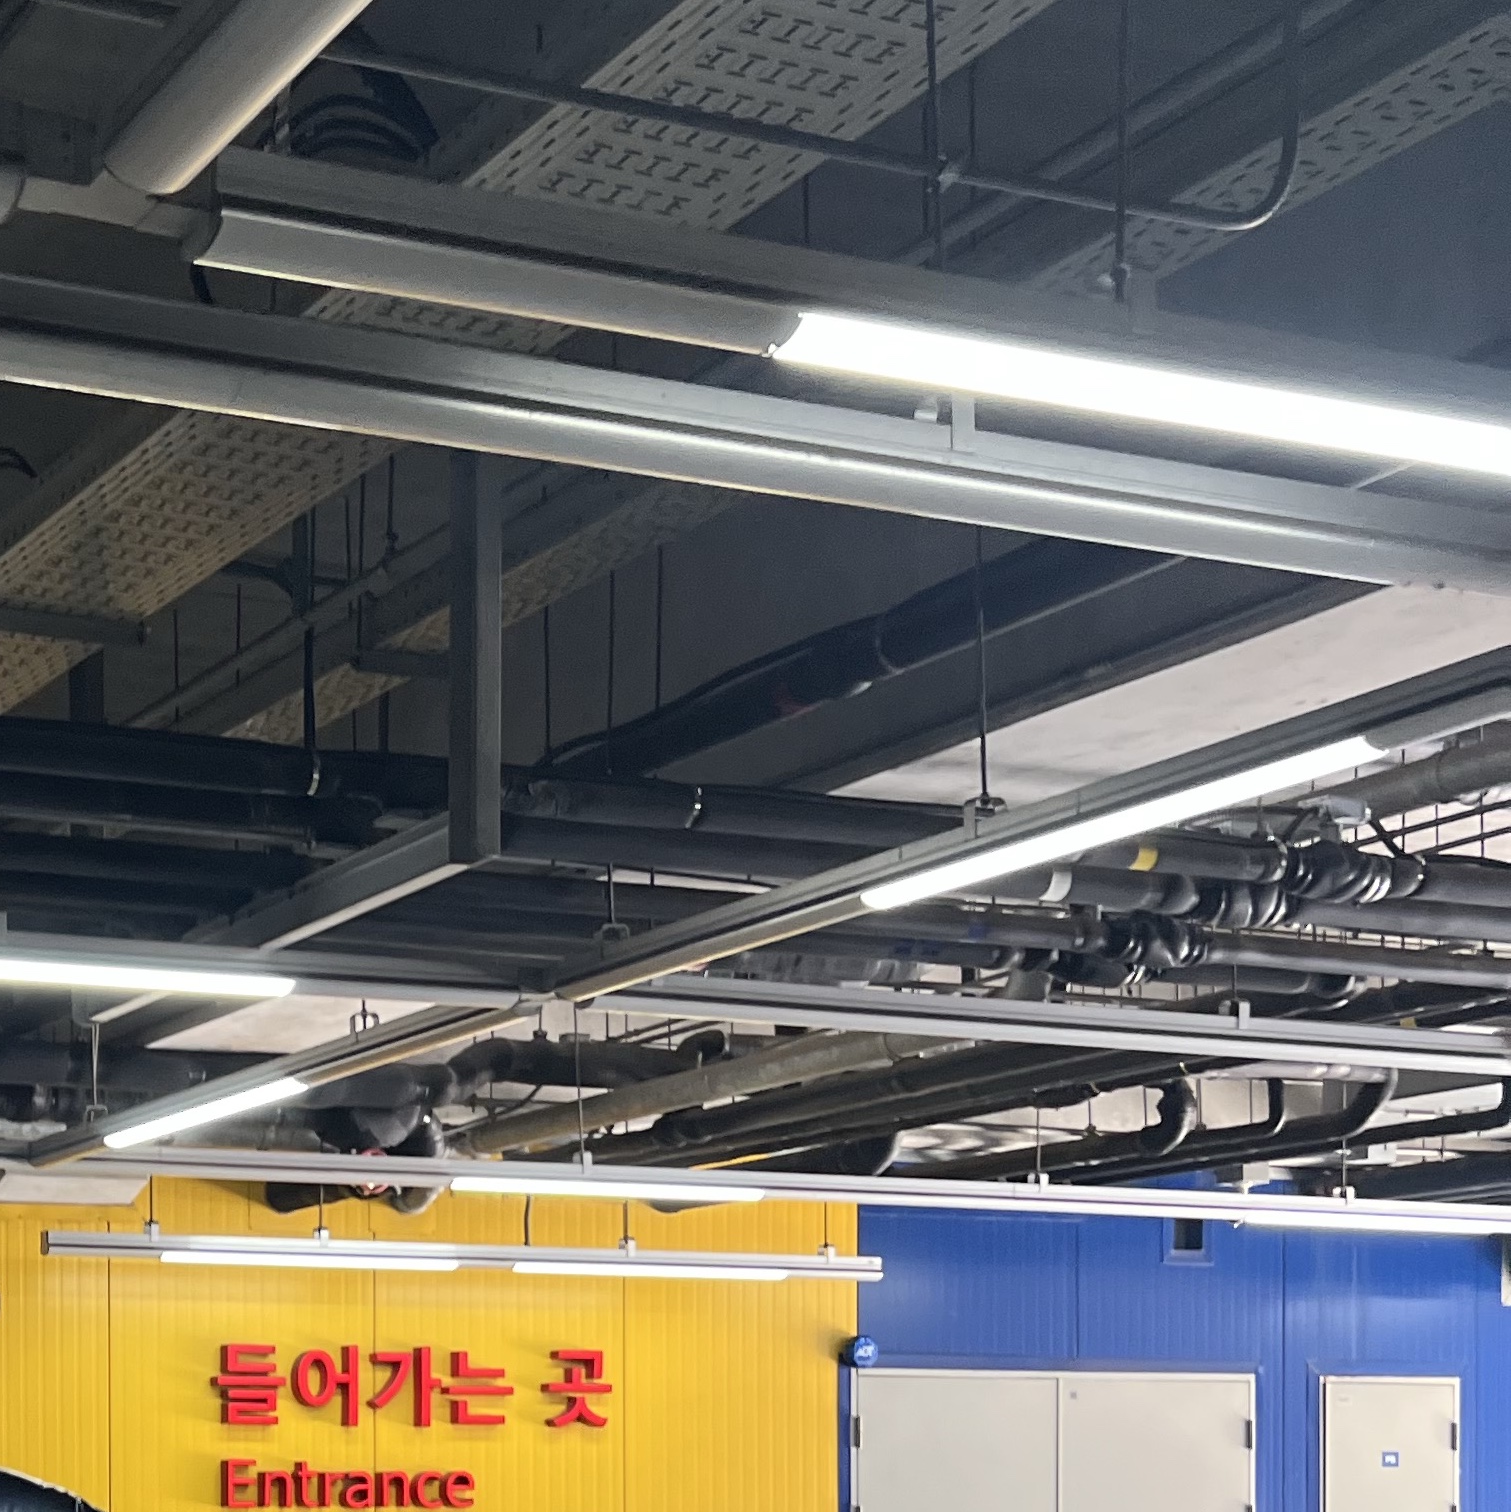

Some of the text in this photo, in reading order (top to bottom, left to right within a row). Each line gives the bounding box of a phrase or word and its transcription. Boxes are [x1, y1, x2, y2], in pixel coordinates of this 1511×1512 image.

[210, 1344, 613, 1427] 들어가는 곳
[220, 1459, 475, 1509] Entrance
